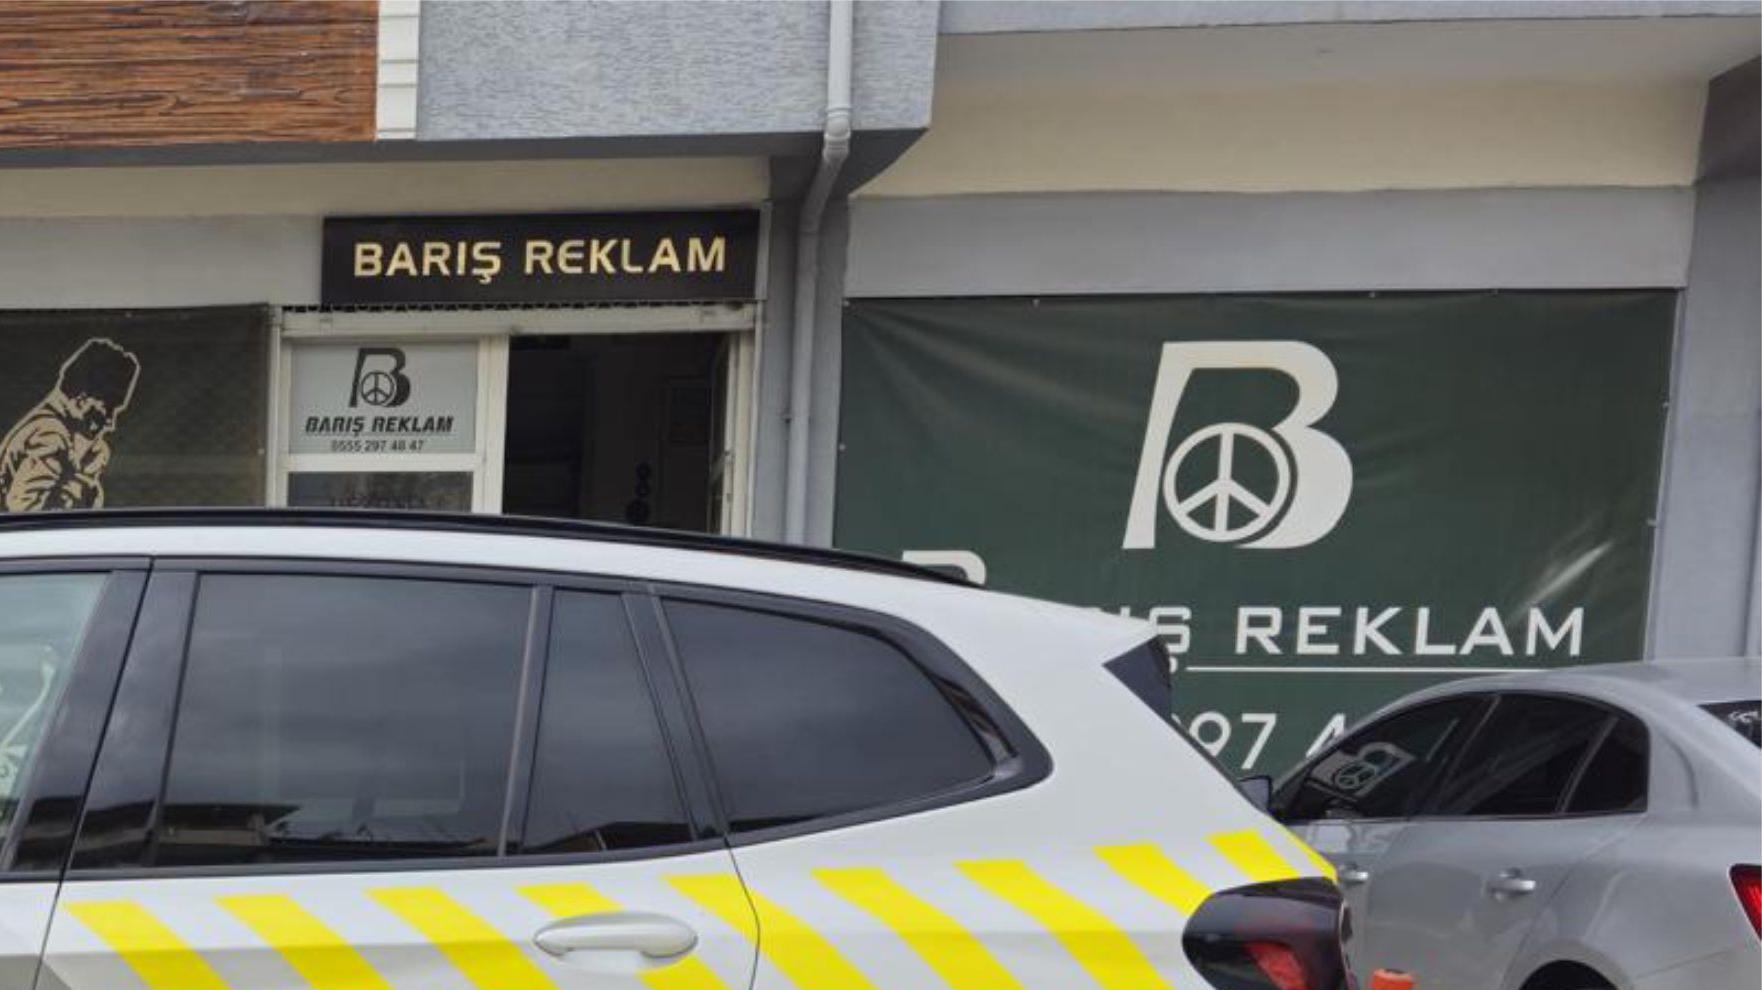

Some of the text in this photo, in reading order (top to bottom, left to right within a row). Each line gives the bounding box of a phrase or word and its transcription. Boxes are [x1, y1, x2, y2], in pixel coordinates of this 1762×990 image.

[354, 235, 726, 284] BARIŞ REKLAM
[305, 416, 454, 436] BARIŞ REKLAM
[1235, 605, 1584, 657] REKLAM
